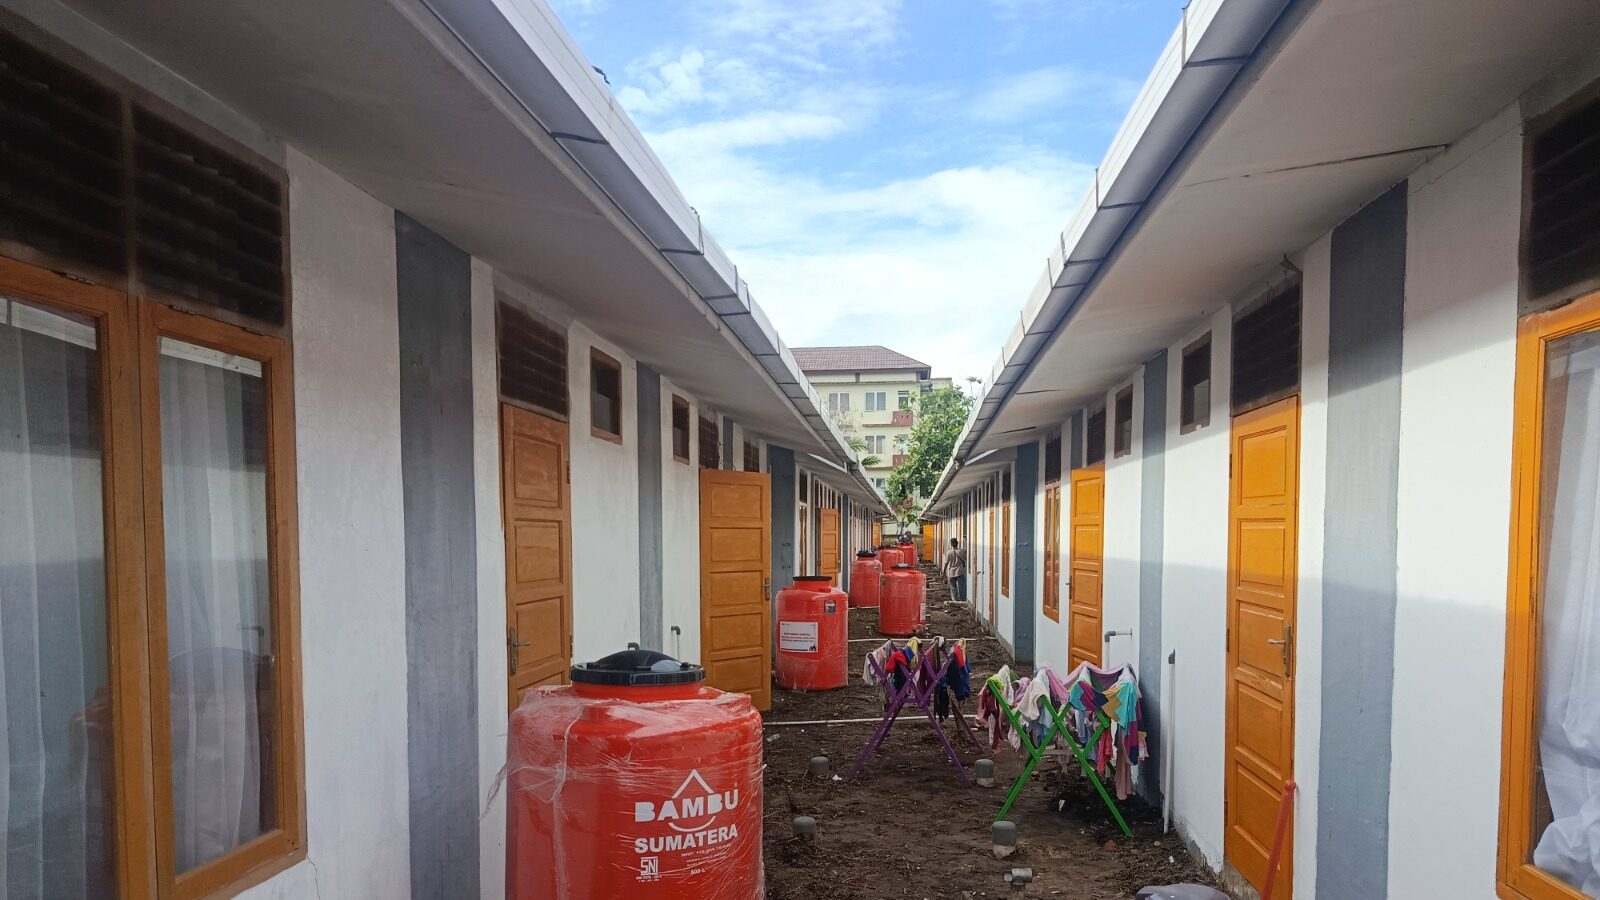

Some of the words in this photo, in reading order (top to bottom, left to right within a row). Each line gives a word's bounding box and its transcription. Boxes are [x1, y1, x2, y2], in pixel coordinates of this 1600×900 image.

[634, 788, 739, 822] BAMBU
[634, 823, 738, 854] SUMATERA
[640, 856, 659, 876] SNI
